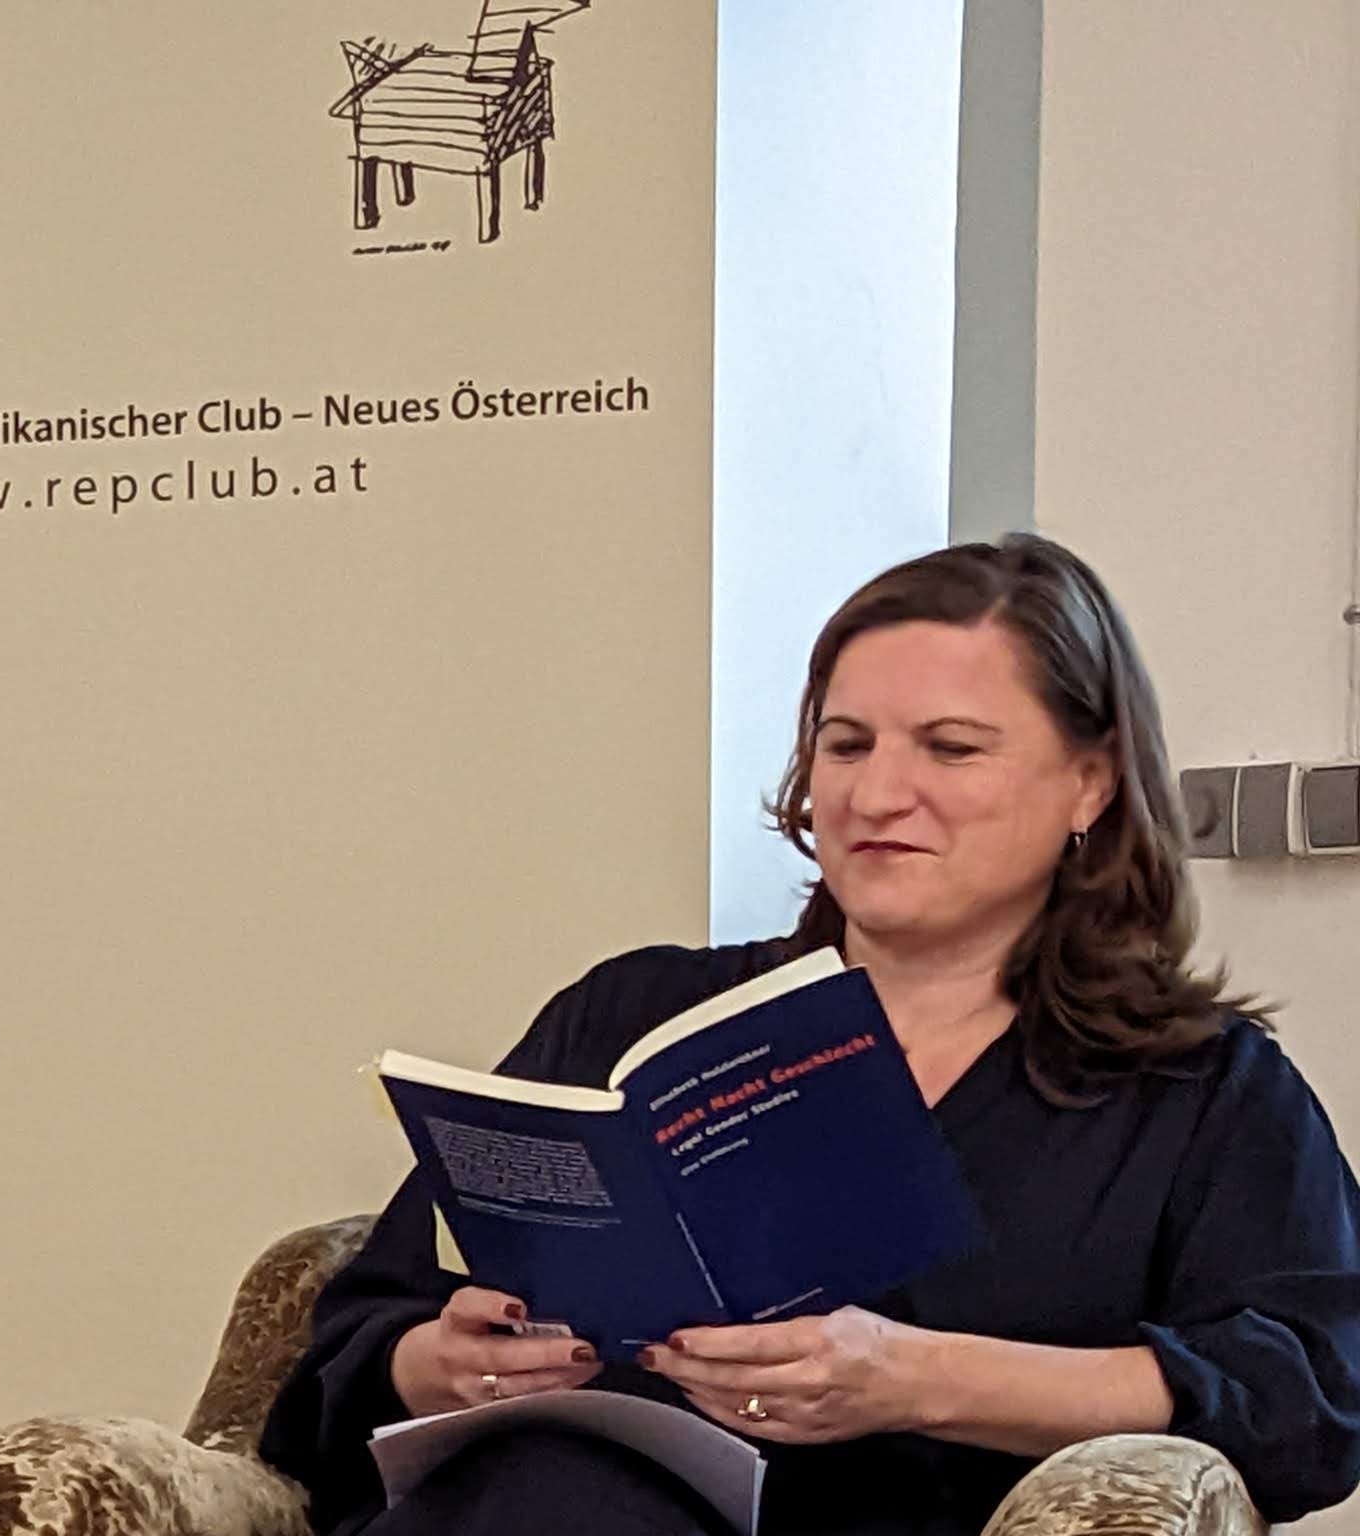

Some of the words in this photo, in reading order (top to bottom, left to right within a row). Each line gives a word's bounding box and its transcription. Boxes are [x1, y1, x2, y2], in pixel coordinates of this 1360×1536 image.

[197, 397, 283, 433] Club
[323, 394, 441, 427] Neues
[450, 379, 649, 420] Österreich
